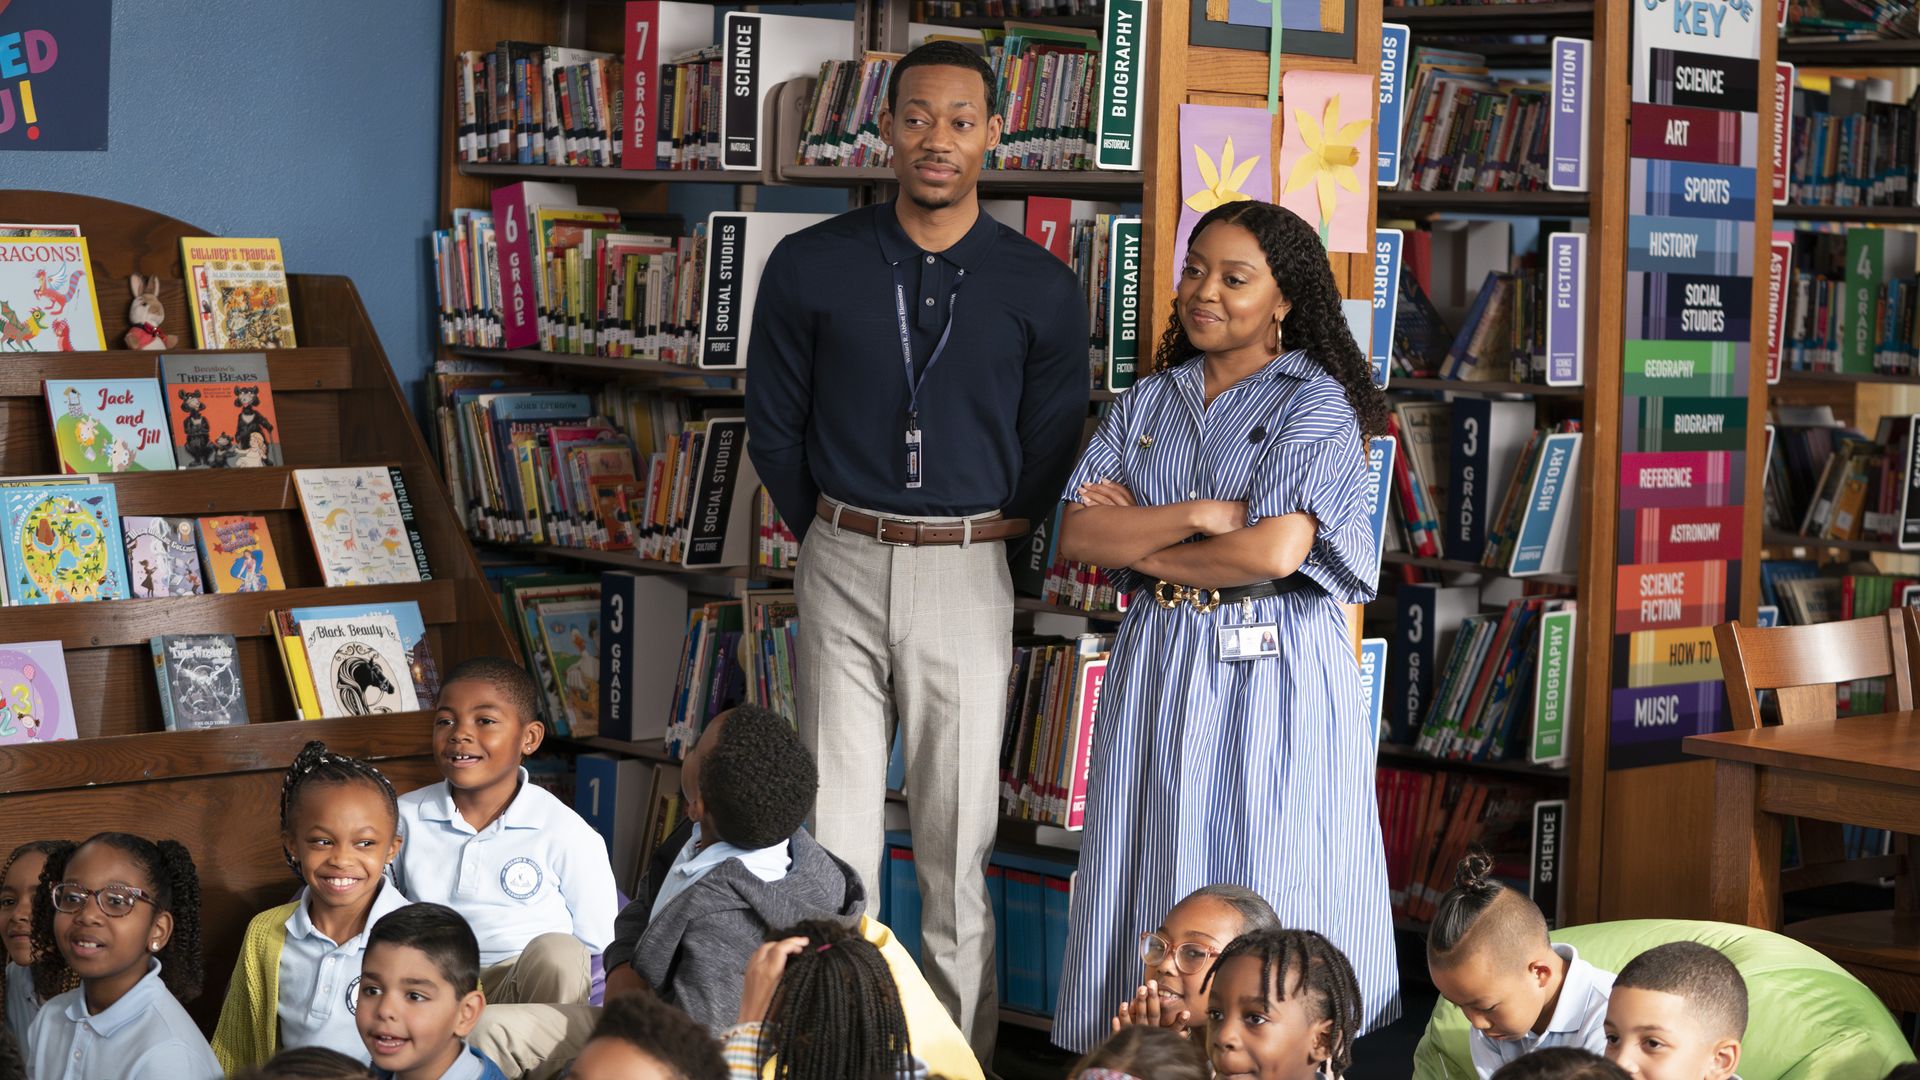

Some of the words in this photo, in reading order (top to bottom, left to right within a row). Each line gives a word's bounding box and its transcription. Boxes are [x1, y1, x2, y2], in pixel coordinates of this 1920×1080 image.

[1673, 0, 1727, 38] KEY
[636, 21, 649, 61] 7
[735, 24, 752, 97] SCIENCE
[1111, 9, 1133, 118] BIOGRAPHY
[1379, 36, 1398, 105] SPORTS
[1561, 48, 1577, 114] FICTION
[1675, 65, 1725, 95] SCIENCE
[635, 71, 646, 148] GRADE
[730, 142, 752, 152] NATURAL
[1103, 139, 1131, 150] HISTORICAL
[1664, 119, 1690, 147] ART
[1684, 176, 1731, 205] SPORTS
[504, 204, 519, 244] 6
[1041, 221, 1057, 251] 7
[719, 224, 736, 280] STUDIES
[1649, 232, 1699, 259] HISTORY
[1856, 245, 1872, 280] 4
[509, 252, 525, 327] GRADE
[1121, 233, 1140, 341] BIOGRAPHY
[1374, 241, 1392, 309] SPORTS
[1557, 244, 1572, 309] FICTION
[1685, 283, 1722, 307] SOCIAL
[716, 283, 733, 332] SOCIAL
[1681, 309, 1725, 333] STUDIES
[1856, 288, 1869, 356] GRADE
[711, 341, 731, 352] PEOPLE
[177, 373, 216, 383] THREE
[218, 372, 258, 382] BEARS
[1116, 363, 1136, 373] FICTION
[1644, 359, 1695, 379] GEOGRAPHY
[97, 387, 134, 411] Jack
[115, 409, 145, 427] and
[136, 427, 161, 451] Jill
[1463, 417, 1479, 457] 3
[1674, 414, 1725, 434] BIOGRAPHY
[713, 429, 735, 482] STUDIES
[390, 470, 415, 521] Alphabet
[1367, 448, 1384, 515] SPORTS
[1537, 447, 1566, 511] HISTORY
[1639, 467, 1692, 489] REFERENCE
[703, 486, 724, 533] SOCIAL
[1461, 466, 1475, 542] GRADE
[694, 541, 718, 552] CULTURE
[1030, 518, 1047, 570] ADE
[1669, 522, 1721, 544] ASTRONOMY
[409, 530, 433, 582] Dinosaur
[1640, 572, 1685, 597] SCIENCE
[610, 593, 624, 634] 3
[1408, 604, 1423, 643] 3
[1640, 598, 1682, 623] FICTION
[316, 624, 346, 639] Black
[347, 623, 385, 640] Beauty
[1544, 624, 1564, 722] GEOGRAPHY
[1669, 641, 1696, 667] HOW
[1699, 640, 1712, 664] TO
[11, 684, 32, 715] 3
[611, 643, 623, 719] GRADE
[1361, 651, 1376, 716] SPOR
[1408, 652, 1420, 726] GRADE
[1634, 694, 1680, 728] MUSIC
[589, 777, 600, 817] 1
[1540, 812, 1557, 883] SCIENCE
